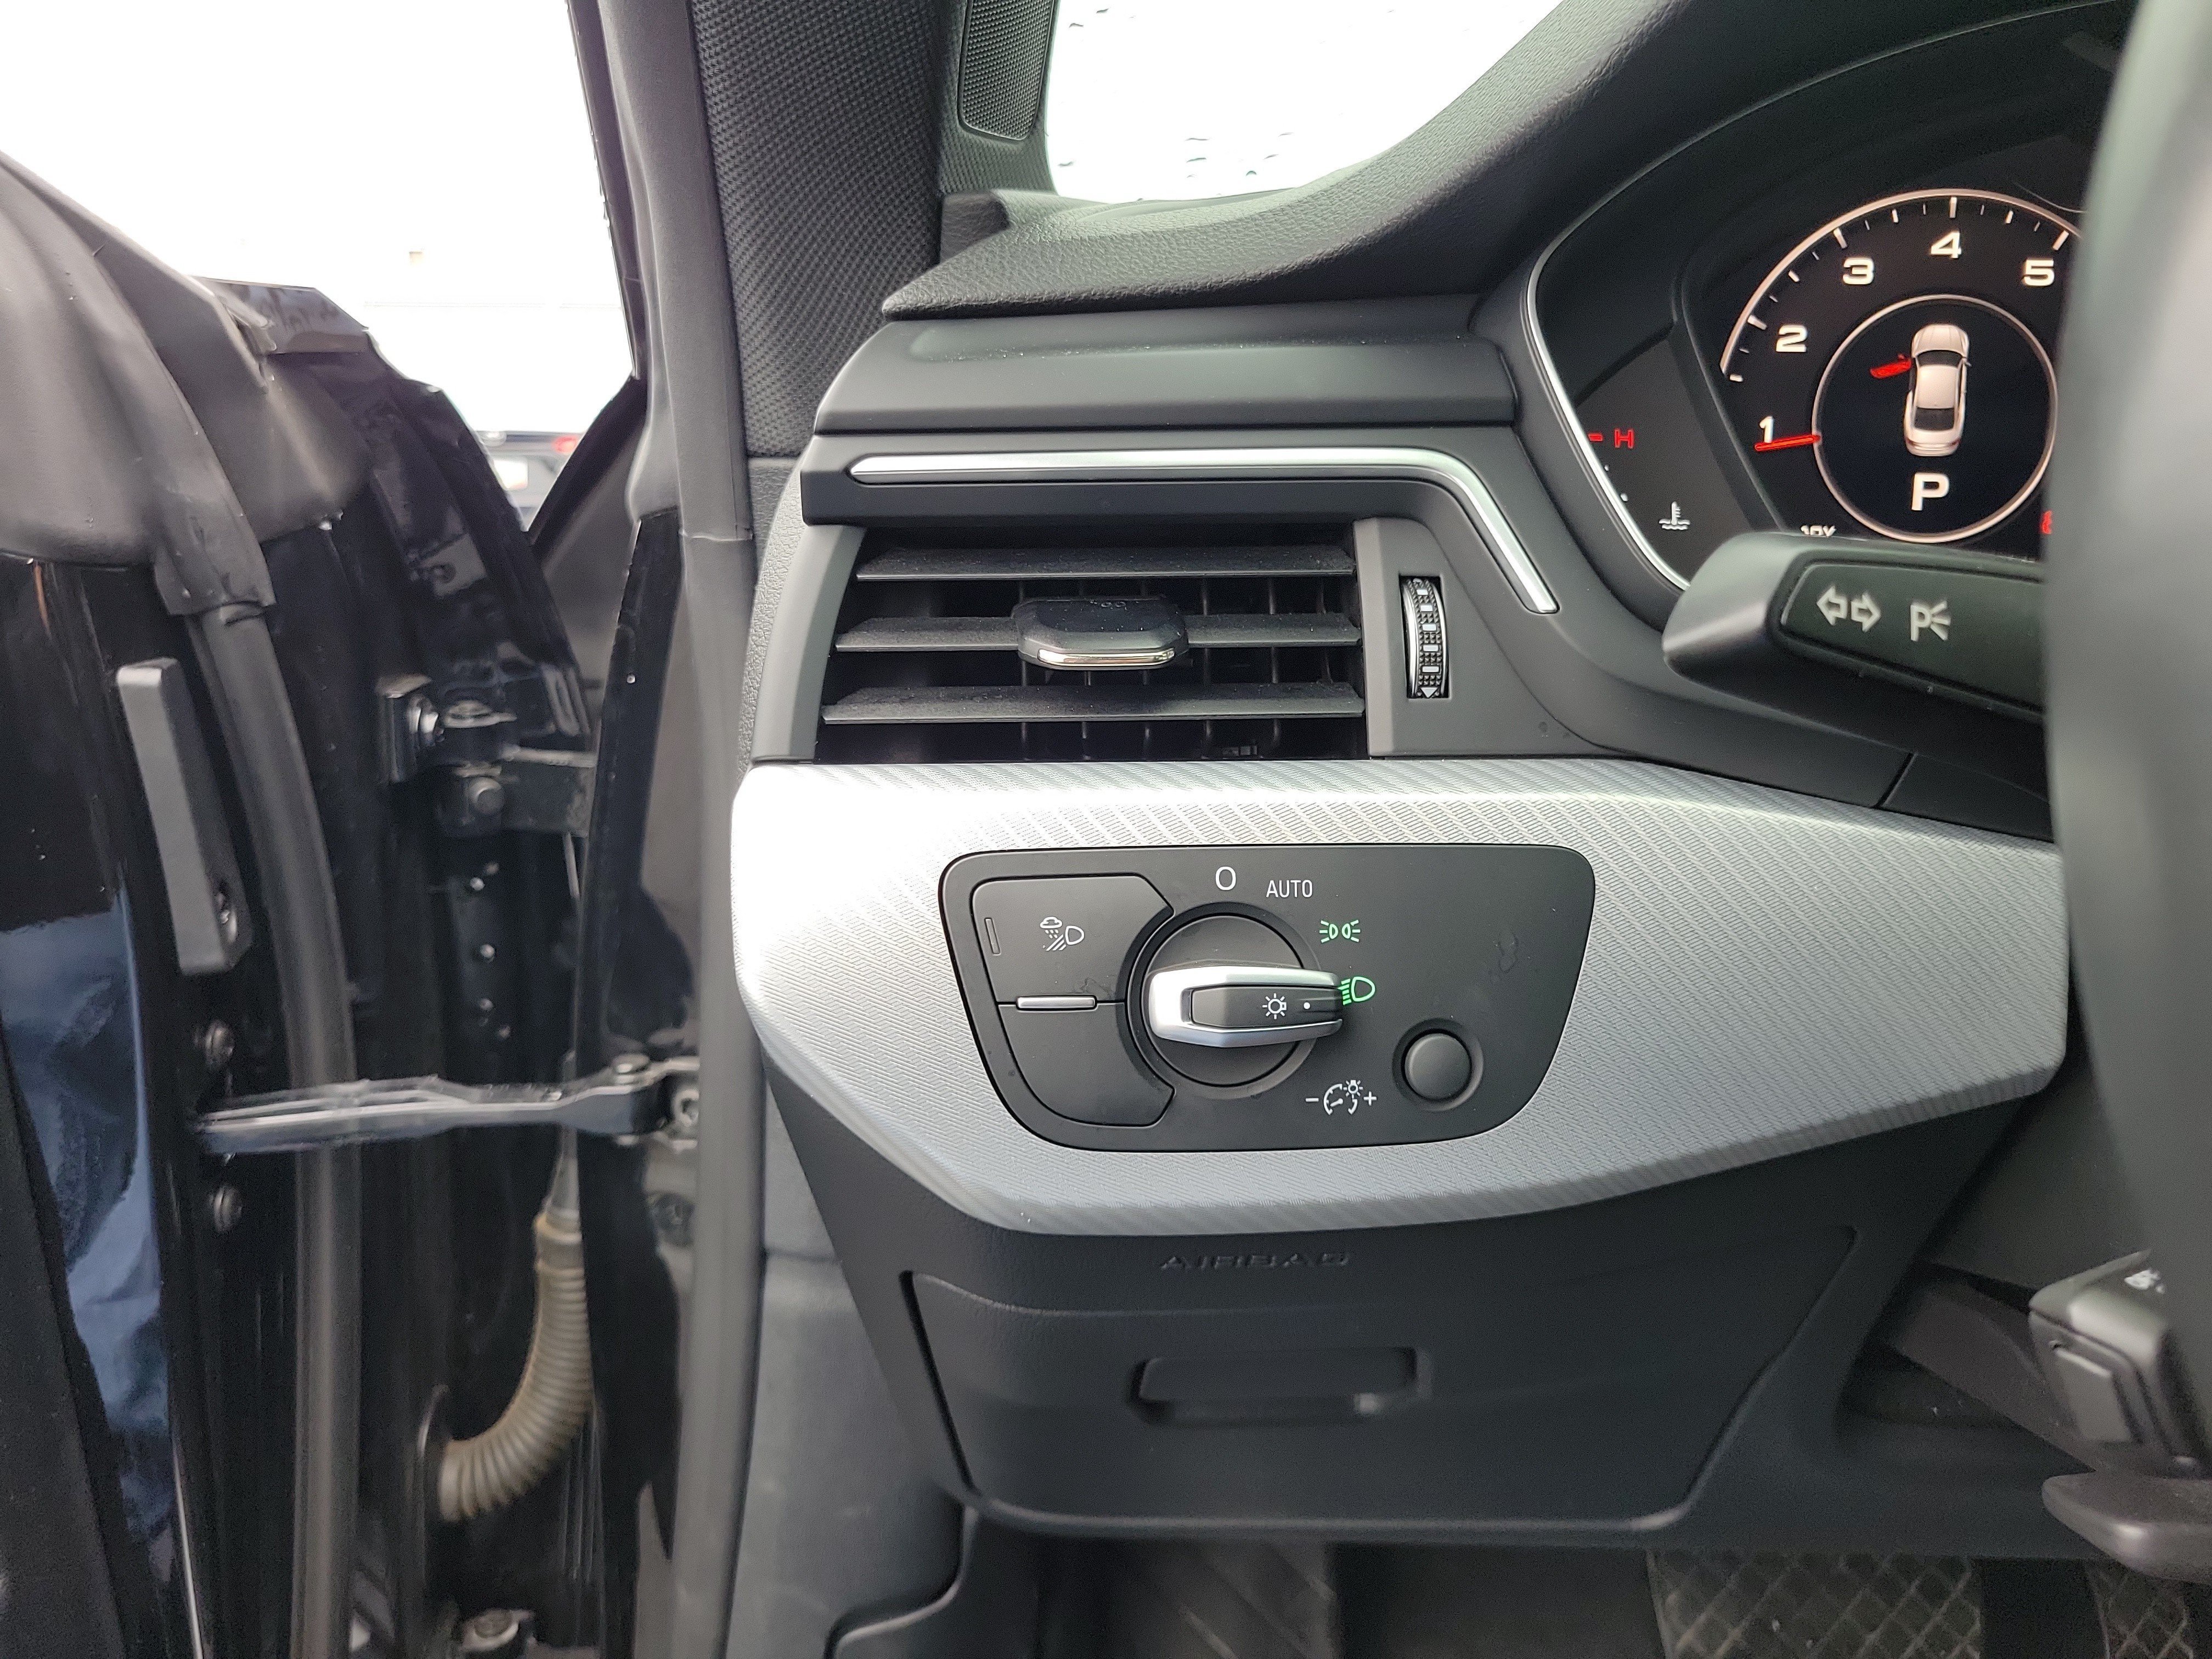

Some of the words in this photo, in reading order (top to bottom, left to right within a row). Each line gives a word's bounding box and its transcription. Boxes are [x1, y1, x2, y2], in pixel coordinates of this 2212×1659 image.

[1930, 230, 1962, 259] 4
[1842, 257, 1875, 285] 3
[2022, 258, 2055, 287] 5
[1775, 324, 1808, 353] 2
[1614, 428, 1634, 449] H
[1759, 415, 1774, 443] 1
[1911, 472, 1949, 511] P
[1266, 879, 1313, 898] AUTO
[1160, 1252, 1351, 1270] AIRBAG
